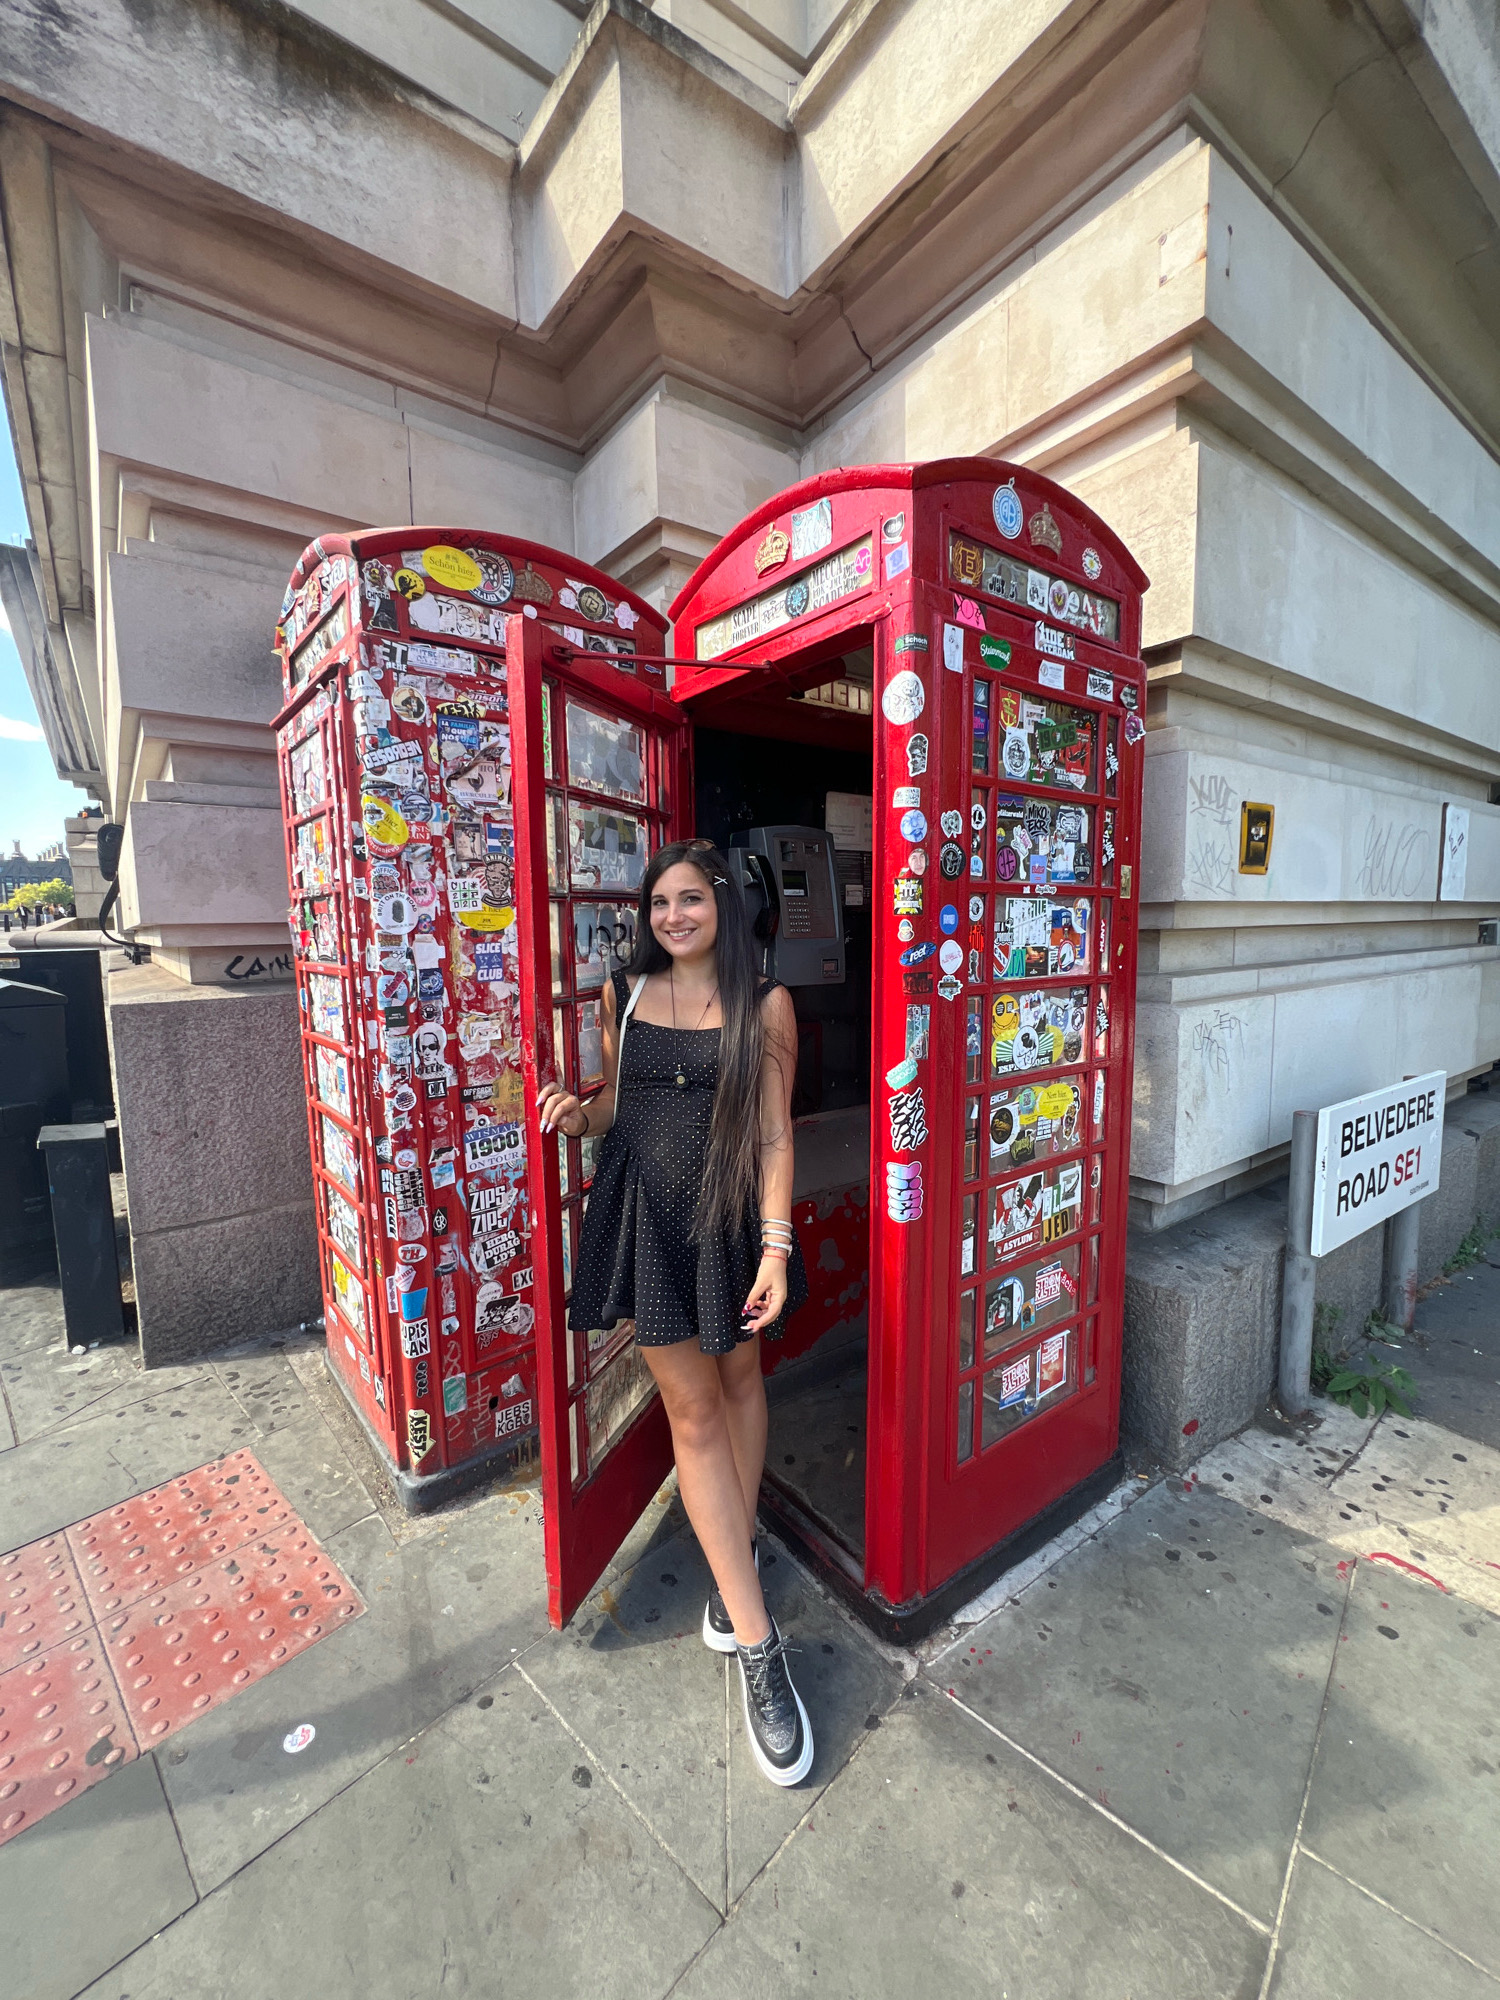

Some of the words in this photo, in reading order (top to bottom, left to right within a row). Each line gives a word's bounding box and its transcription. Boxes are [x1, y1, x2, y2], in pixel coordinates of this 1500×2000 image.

[429, 556, 456, 572] Schön
[733, 603, 758, 628] SCAPE
[732, 621, 759, 644] FOREVER
[441, 720, 449, 728] LA
[450, 728, 467, 736] QUE
[441, 733, 459, 742] NOS
[485, 853, 513, 866] ANIMAL
[475, 942, 501, 954] SLICE
[477, 968, 503, 981] CLUB
[465, 1122, 518, 1141] WISMAR
[1340, 1090, 1436, 1158] BELVEDERE
[471, 1131, 520, 1160] 1900
[469, 1159, 487, 1171] ON
[488, 1152, 519, 1167] TOUR
[1336, 1161, 1390, 1217] ROAD
[1393, 1145, 1421, 1187] SE1
[470, 1186, 506, 1213] ZIPS
[471, 1211, 508, 1235] ZIPS
[1044, 1210, 1069, 1243] JED
[485, 1237, 521, 1259] DURAG
[486, 1230, 516, 1249] HERO
[1003, 1232, 1033, 1252] ASYLUM
[1035, 1284, 1061, 1301] KASTEN
[1002, 1371, 1030, 1395] KASTEN
[498, 1402, 531, 1423] JEBS
[497, 1416, 523, 1436] KGB
